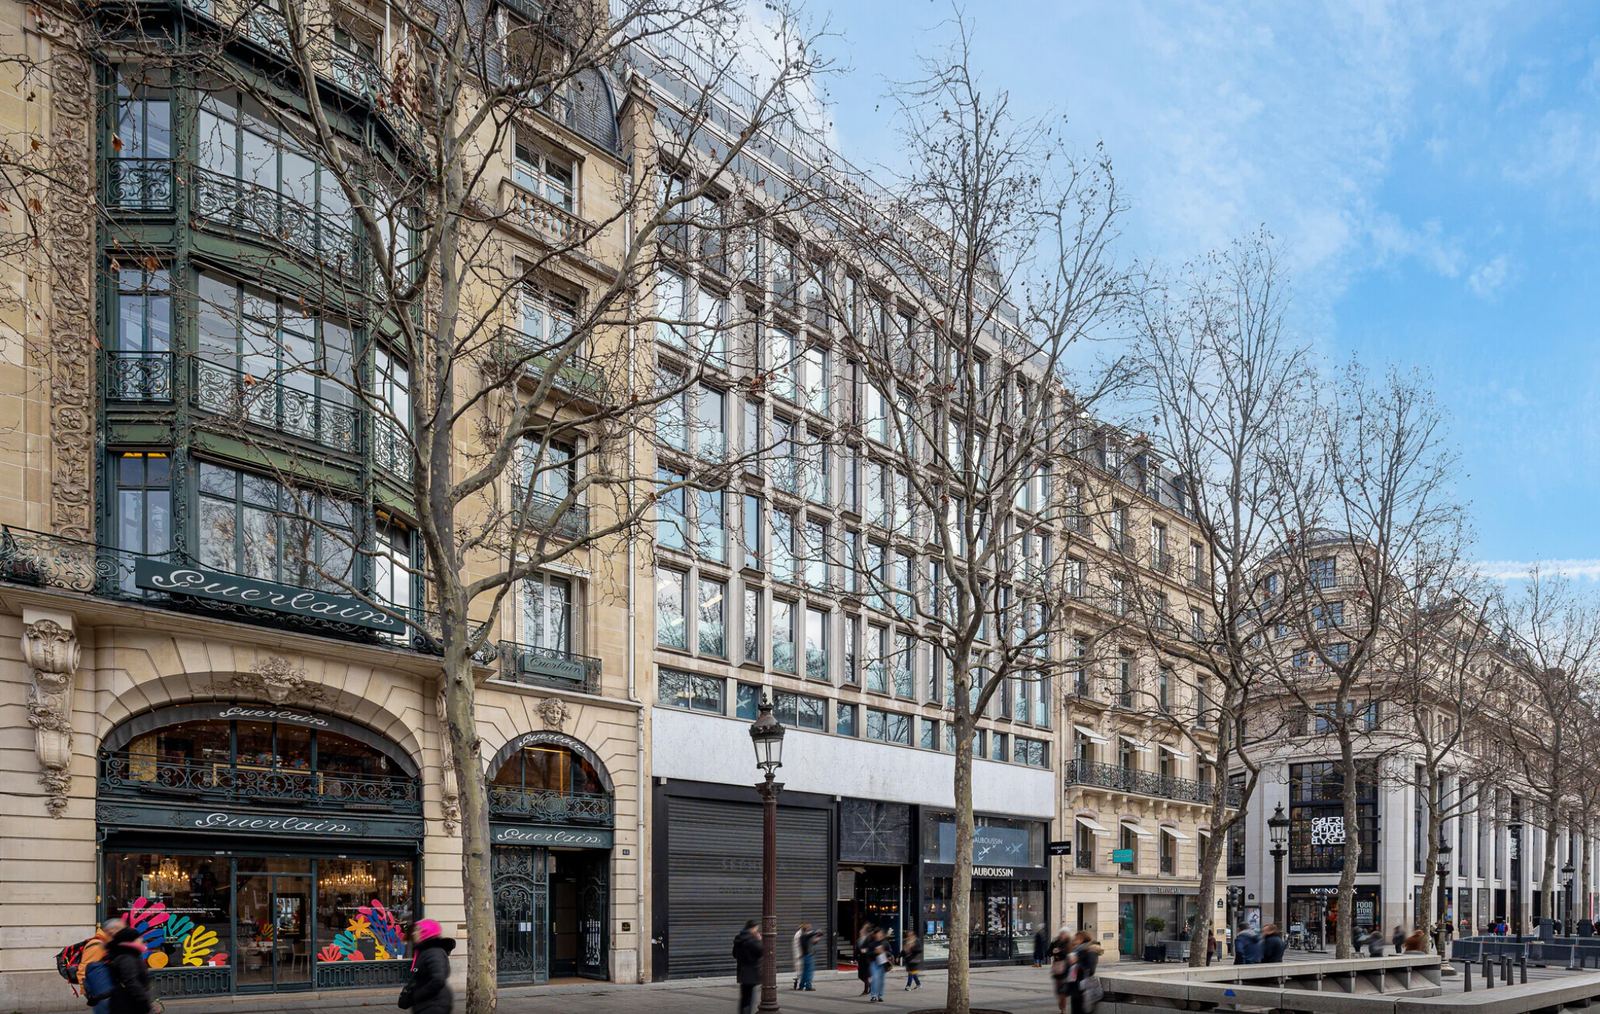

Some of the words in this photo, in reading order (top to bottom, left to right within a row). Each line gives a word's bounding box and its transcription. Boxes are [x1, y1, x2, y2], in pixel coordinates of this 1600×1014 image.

[151, 569, 395, 626] Guerlain
[218, 706, 329, 727] Guerlain
[519, 733, 586, 753] Guerlain
[195, 812, 351, 832] Guerlain
[497, 828, 601, 844] Guerlain
[973, 836, 1003, 845] AUBOUSSIN
